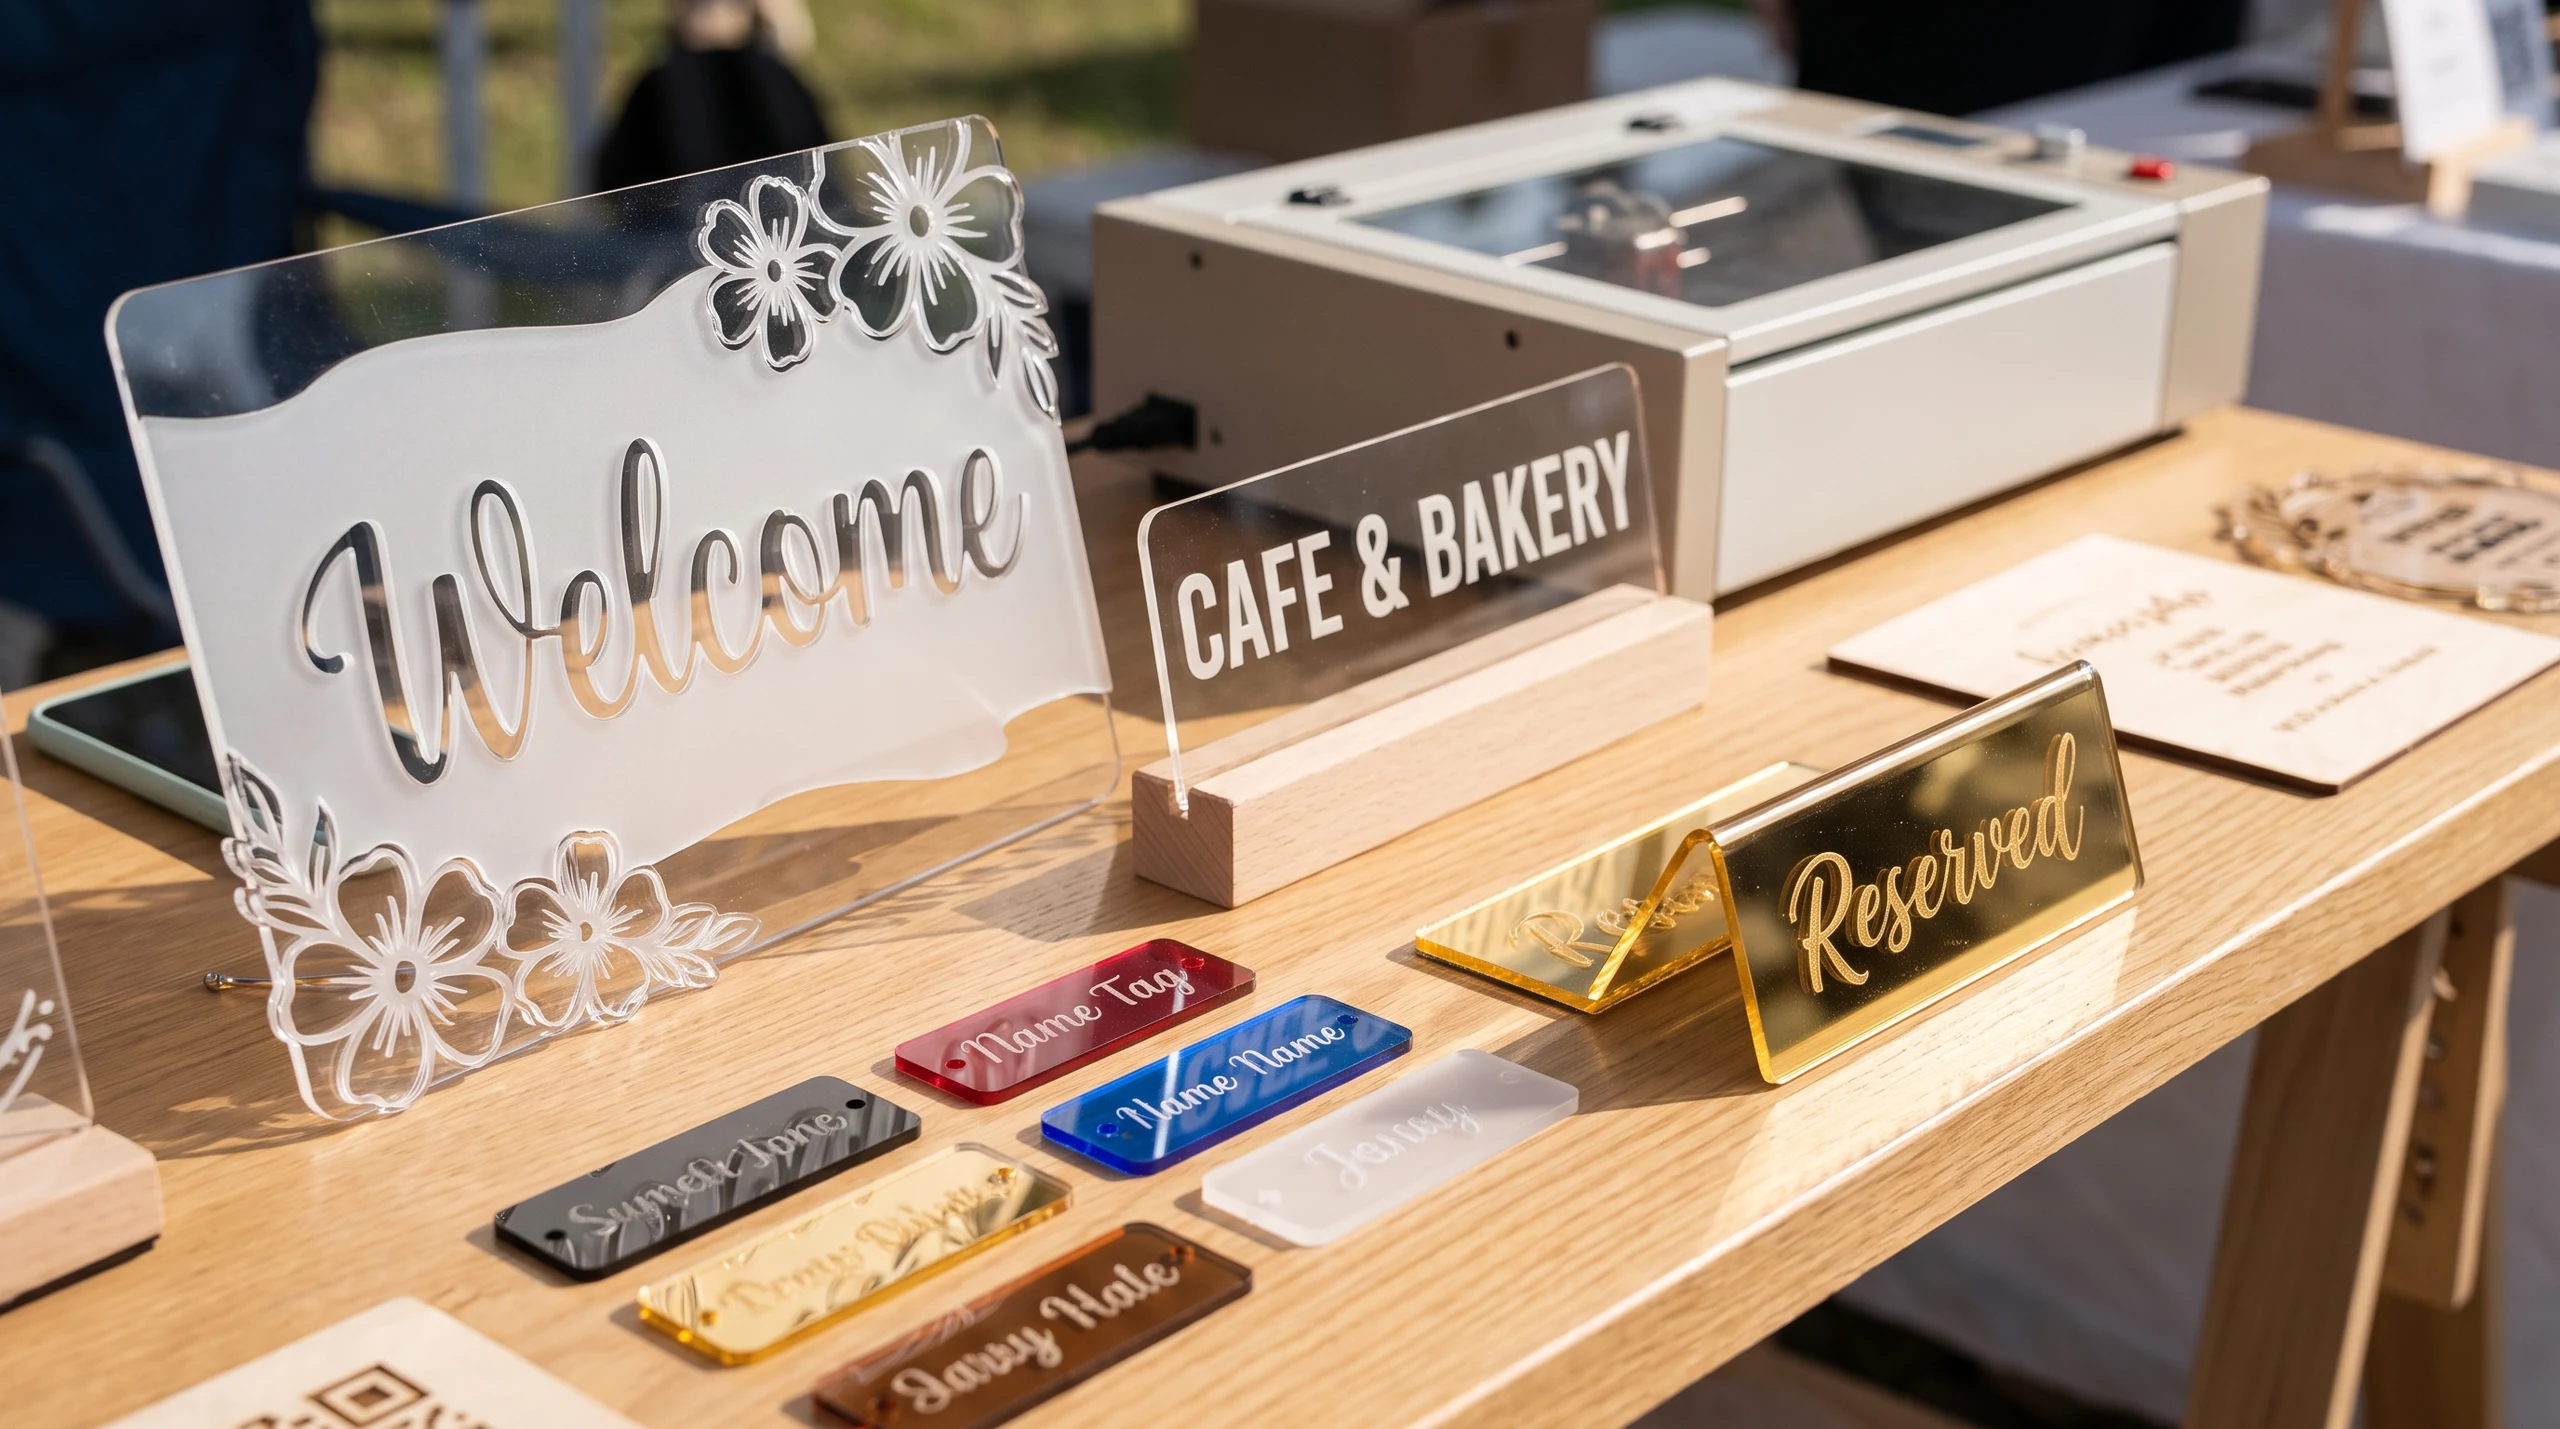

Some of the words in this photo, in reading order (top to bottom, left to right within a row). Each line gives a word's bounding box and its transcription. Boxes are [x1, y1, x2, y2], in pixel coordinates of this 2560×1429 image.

[301, 436, 1031, 788] Welcome
[1177, 529, 1344, 681] CAFE
[1355, 513, 1410, 619] &
[1417, 430, 1632, 599] BAKERY
[1785, 731, 2084, 994] Reserved
[960, 1004, 1103, 1064] Name
[1088, 967, 1197, 1006] Tag
[1115, 1073, 1239, 1131] Name
[1228, 1023, 1346, 1077] Name
